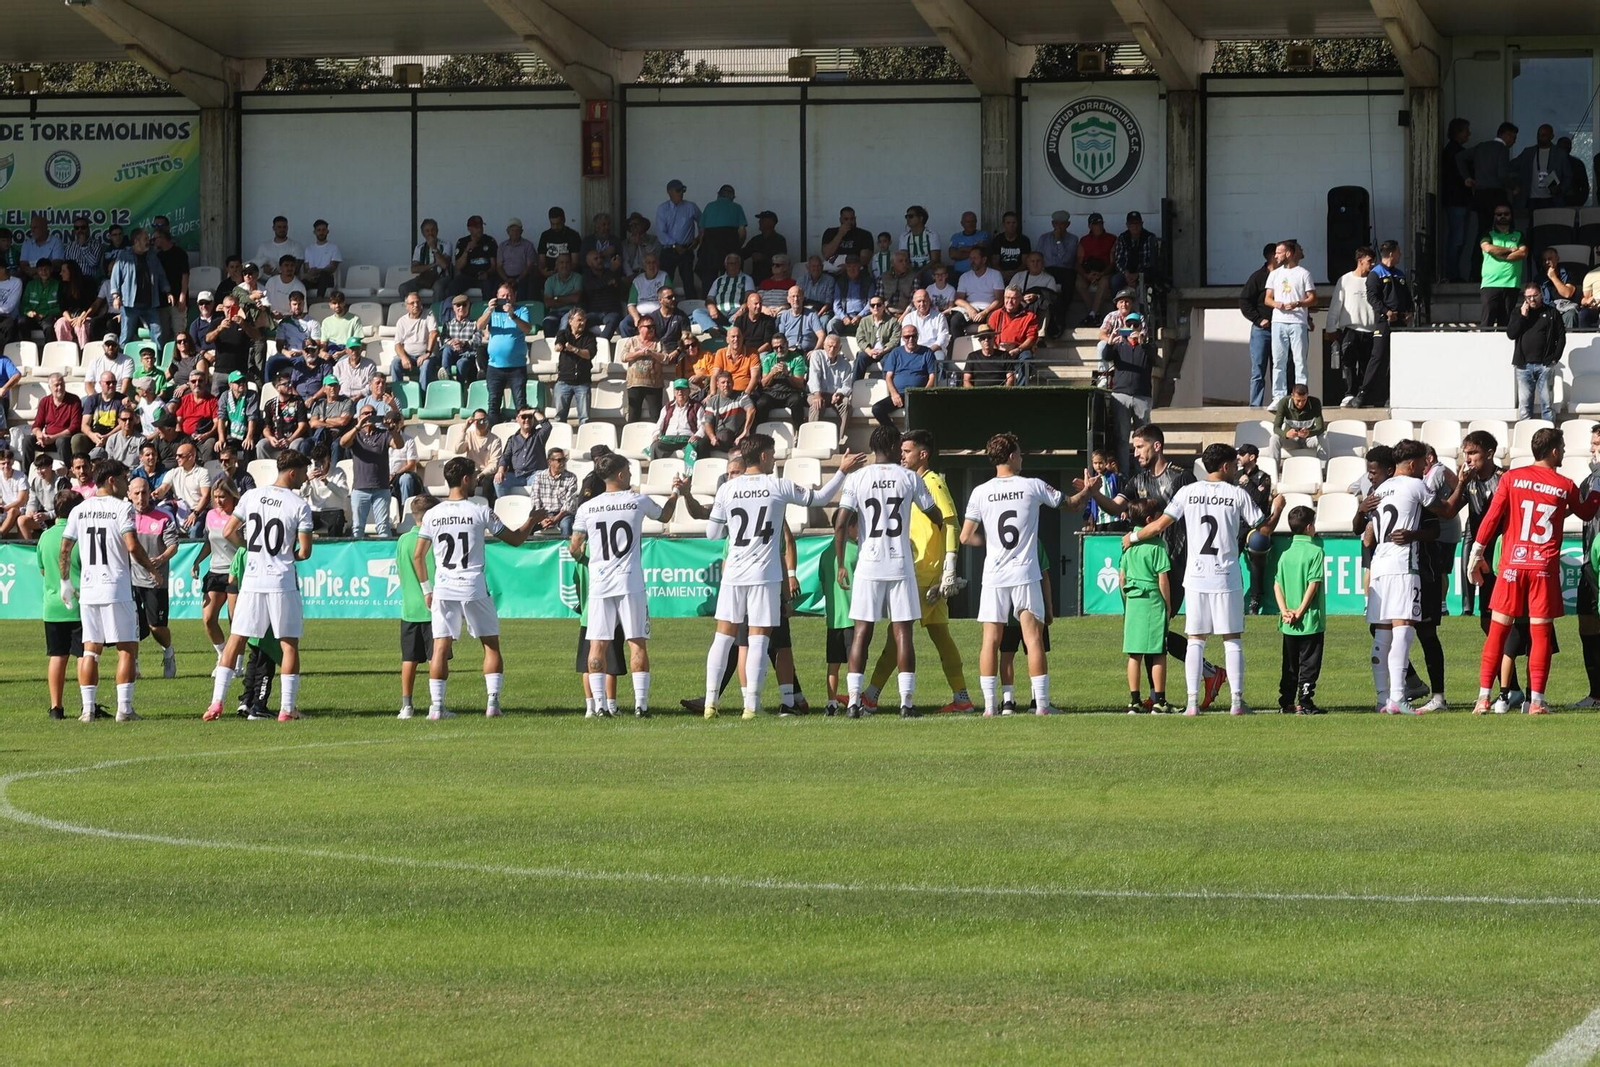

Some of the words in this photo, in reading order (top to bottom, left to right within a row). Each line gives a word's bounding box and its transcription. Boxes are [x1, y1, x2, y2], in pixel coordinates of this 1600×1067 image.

[0, 123, 23, 140] DE
[30, 121, 191, 140] TORREMOLINOS
[1048, 109, 1074, 153] JUVENTUD
[1074, 101, 1137, 136] TORREMOLINOS
[1131, 137, 1139, 153] C.F.
[114, 157, 184, 182] JUNTOS
[1080, 184, 1109, 194] 1958
[6, 209, 26, 225] EL
[111, 209, 130, 224] 12
[732, 489, 770, 499] ALONSO
[872, 480, 897, 489] ALSET
[1513, 478, 1533, 489] JAVI
[1533, 482, 1568, 499] CUENCA
[260, 496, 283, 508] GORI
[988, 491, 1024, 502] CLIMENT
[1189, 496, 1205, 504] EDU
[1206, 495, 1235, 506] LÓPEZ
[588, 504, 605, 514] FRAN
[605, 502, 638, 511] GALLEGO
[864, 496, 905, 538] 23
[431, 516, 474, 527] CHRISTIAN
[730, 505, 774, 547] 24
[997, 509, 1020, 550] 6
[1520, 499, 1558, 544] 13
[248, 512, 285, 557] 20
[595, 519, 633, 561] 10
[1199, 514, 1219, 555] 2
[86, 526, 108, 565] 11
[438, 531, 469, 570] 21
[642, 562, 720, 583] rremoli
